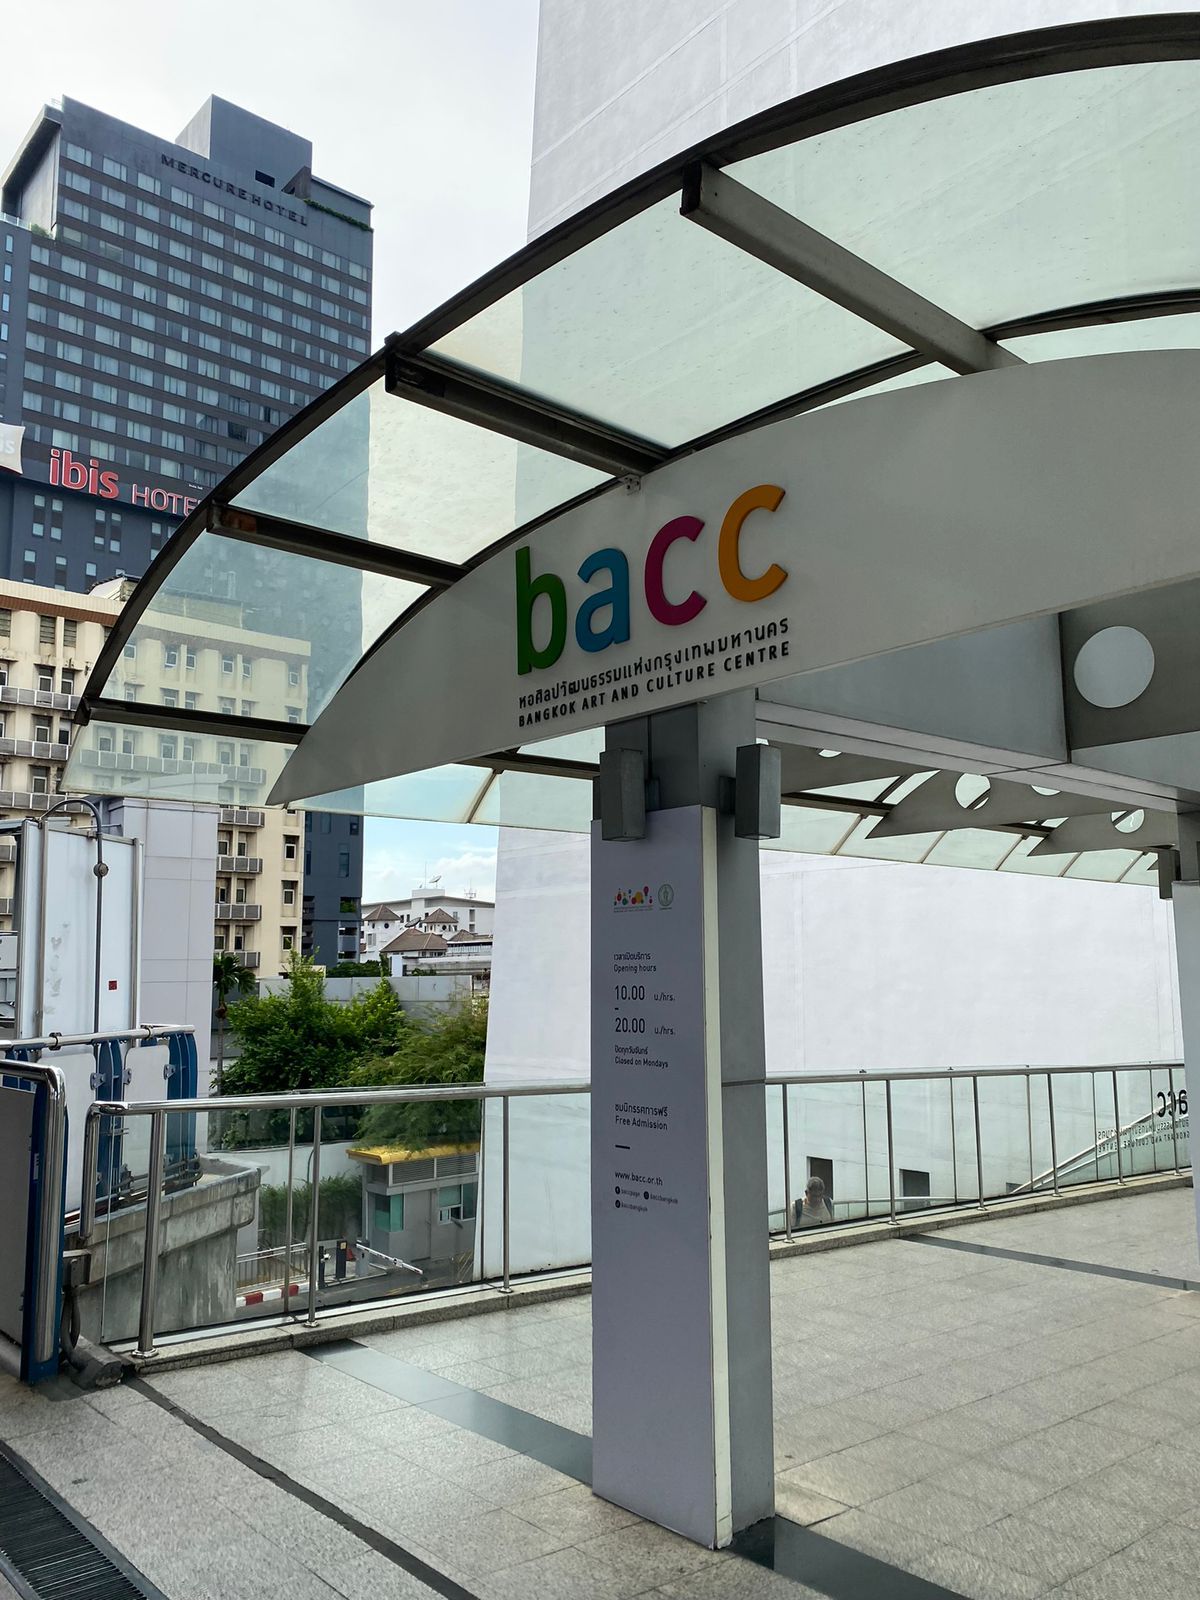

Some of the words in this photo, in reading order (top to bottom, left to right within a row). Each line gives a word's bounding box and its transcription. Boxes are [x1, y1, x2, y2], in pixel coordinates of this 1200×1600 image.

[161, 153, 248, 201] MERCURE
[251, 193, 308, 226] HOTEL
[49, 448, 119, 499] ibis
[132, 483, 202, 517] HOTE
[515, 484, 789, 675] bacc
[519, 617, 790, 709] หอศิลปวัฒนธรรมแห่งกรุงเทพมหานคร
[519, 699, 576, 728] BANGKOK
[581, 692, 605, 711] ART
[611, 684, 640, 702] AND
[646, 662, 716, 693] CULTURE
[723, 640, 790, 672] CENTRE
[614, 964, 638, 974] Opening
[639, 964, 657, 973] hours
[614, 985, 646, 1001] 10.00
[615, 1017, 646, 1034] 20.00
[615, 1056, 634, 1066] Closed
[643, 1059, 669, 1069] Mondays
[615, 1115, 631, 1126] Free
[632, 1116, 668, 1131] Admission
[615, 1171, 663, 1187] www.bacc.or.th
